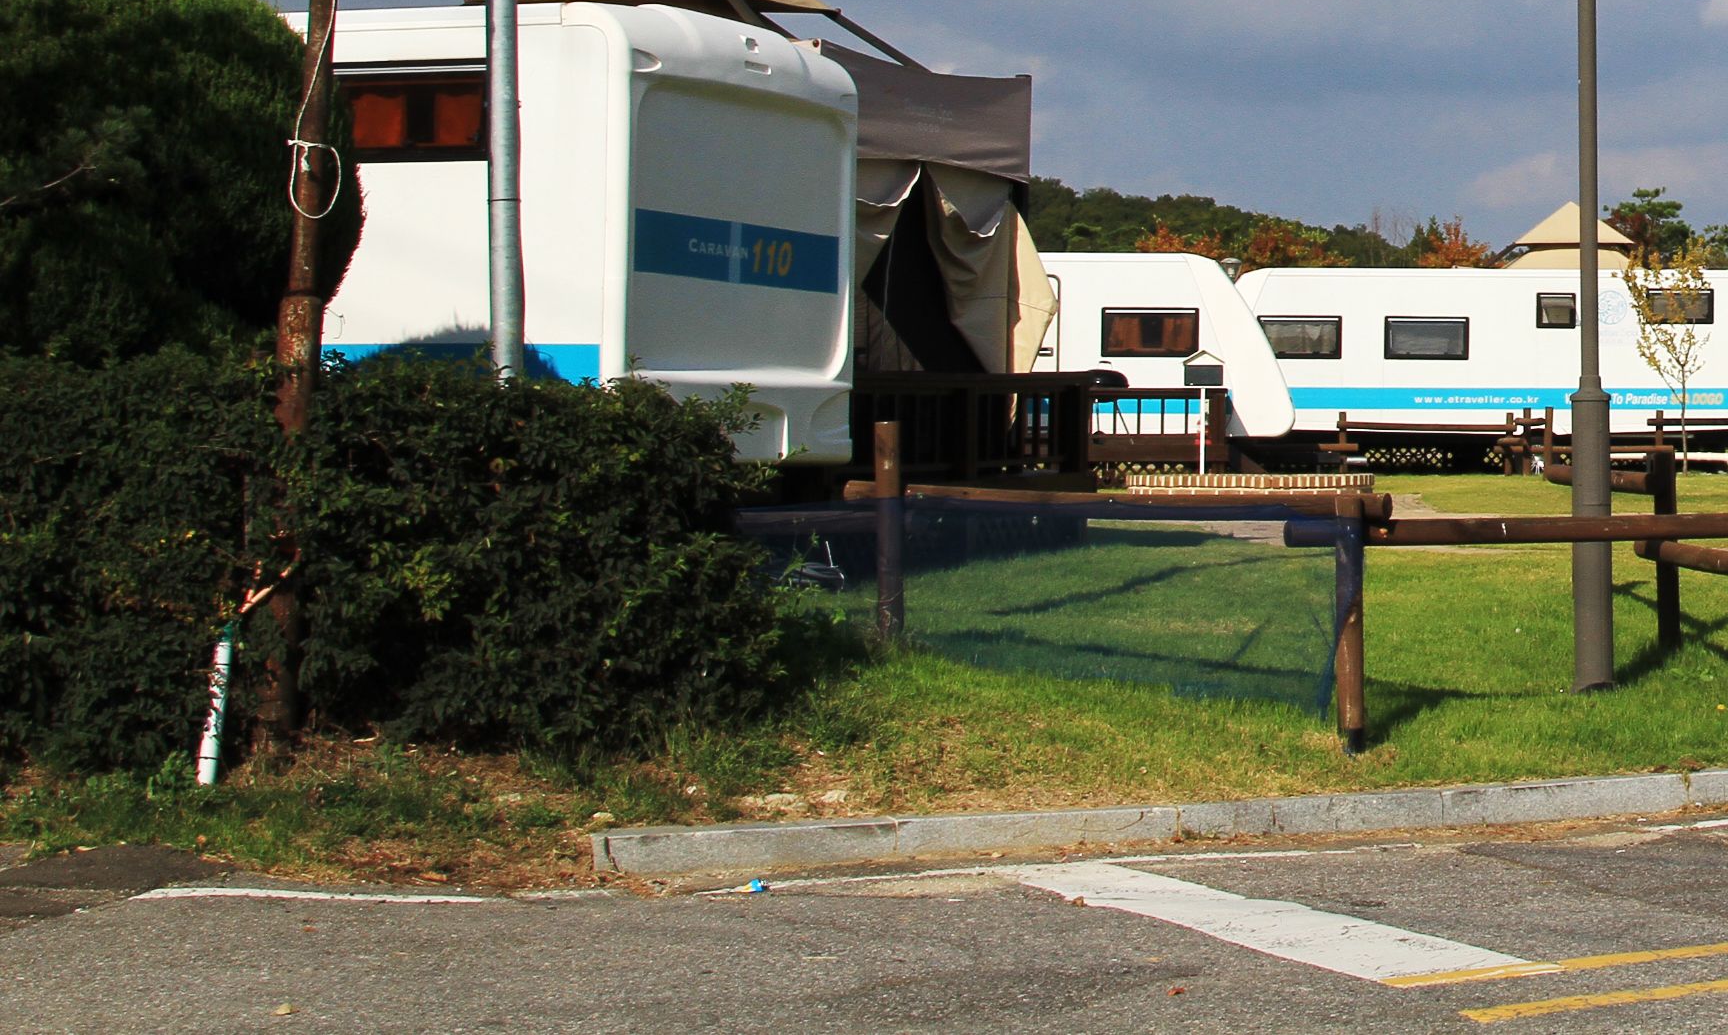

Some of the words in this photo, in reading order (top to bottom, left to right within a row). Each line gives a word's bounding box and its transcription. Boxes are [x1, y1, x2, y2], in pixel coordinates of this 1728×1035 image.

[688, 238, 749, 260] CARAVAN
[752, 237, 793, 277] 110
[1414, 395, 1539, 404] www.etraveller.co.kr
[1611, 392, 1624, 405] To
[1625, 393, 1668, 405] Paradise
[1670, 393, 1690, 405] SPA
[1692, 393, 1724, 405] DOGO
